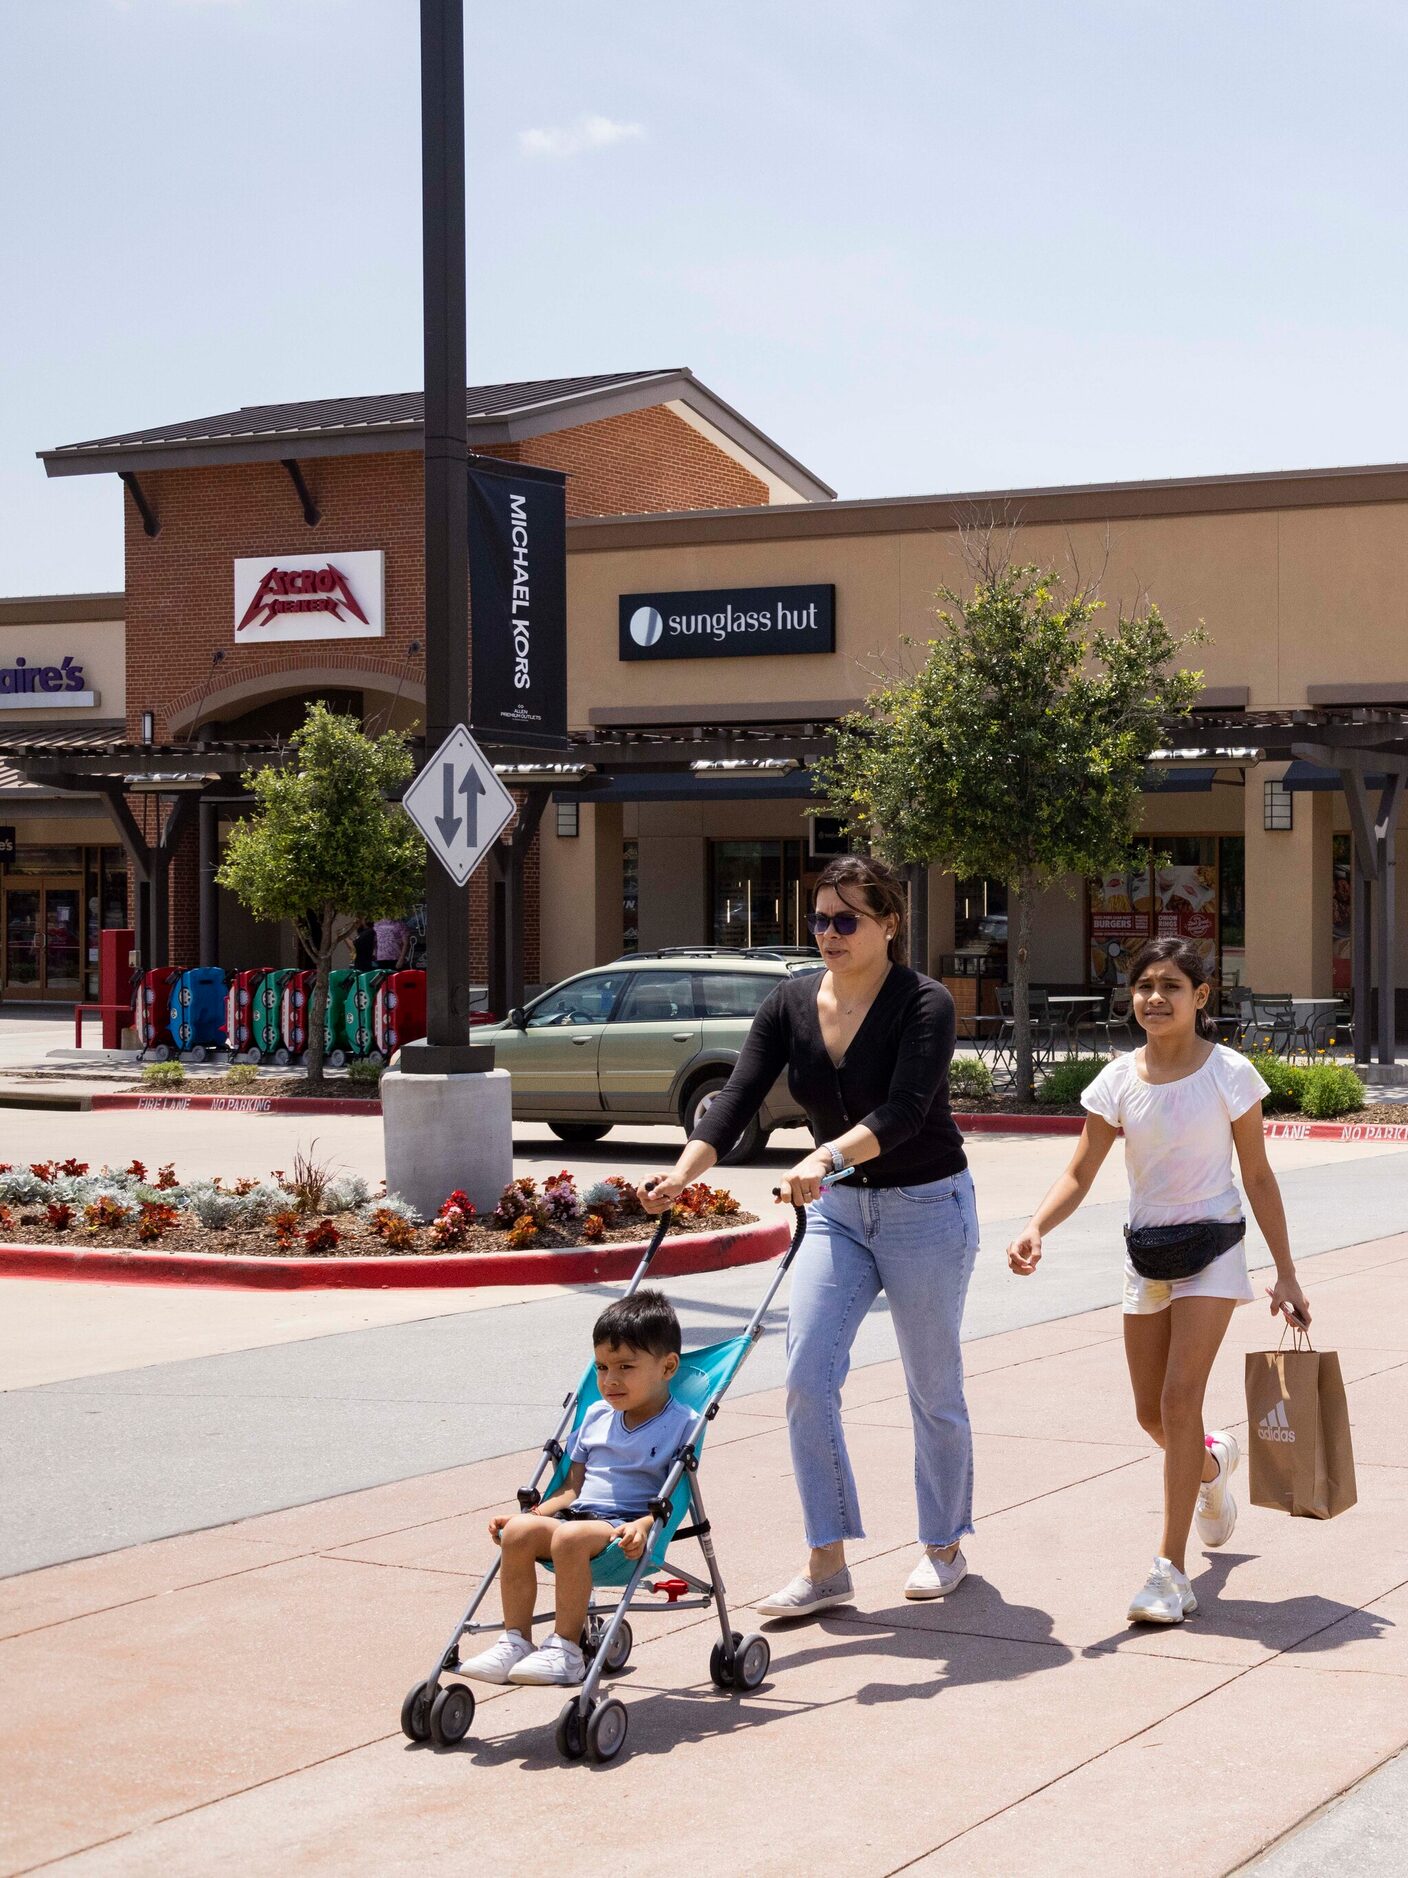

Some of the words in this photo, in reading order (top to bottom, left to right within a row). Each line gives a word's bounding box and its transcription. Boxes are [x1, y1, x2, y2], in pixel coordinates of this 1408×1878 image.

[510, 493, 531, 614] MICHAEL
[668, 604, 772, 641] sunglass
[777, 602, 818, 630] hut
[512, 619, 530, 689] KORS
[1093, 920, 1132, 929] BURGERS
[137, 1097, 161, 1111] FIRE
[163, 1098, 192, 1111] LANE
[210, 1098, 225, 1111] NO
[227, 1099, 271, 1112] PARKING
[1271, 1124, 1311, 1140] LANE
[1341, 1125, 1361, 1140] NO
[1257, 1425, 1296, 1443] adidas
